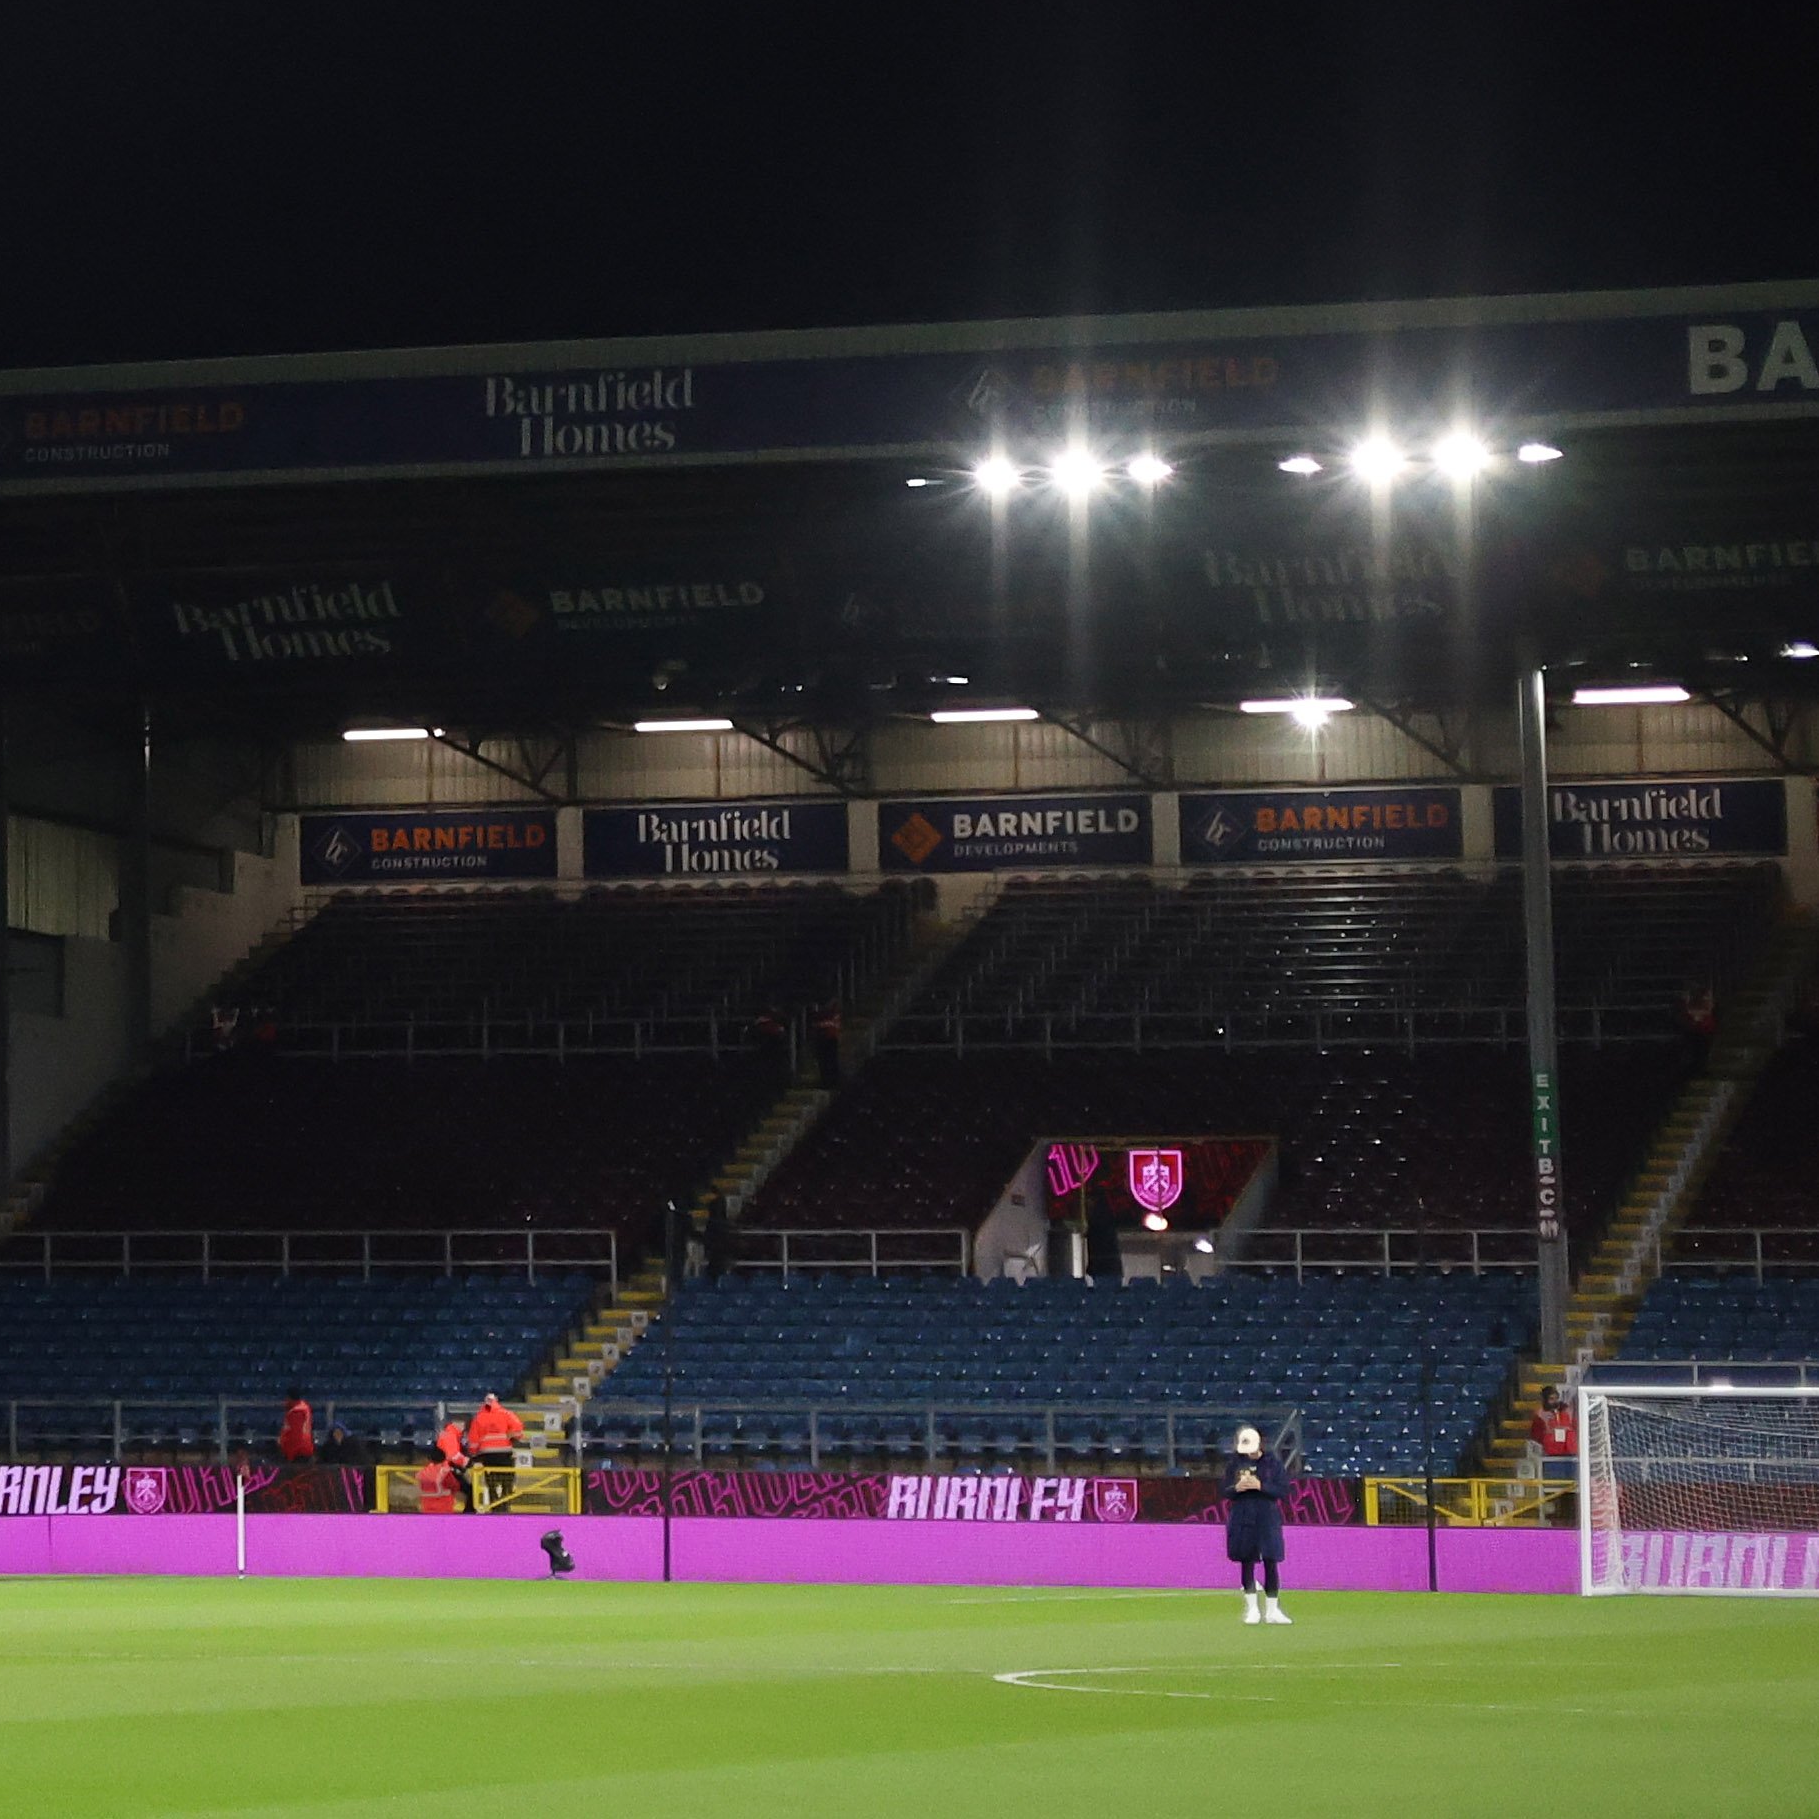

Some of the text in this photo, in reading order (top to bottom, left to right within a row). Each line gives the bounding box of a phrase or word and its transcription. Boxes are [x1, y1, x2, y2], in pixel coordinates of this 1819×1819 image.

[486, 369, 694, 419] Barnfield
[24, 401, 245, 439] BARNFIELD
[24, 442, 170, 463] CONSTRUCTION
[520, 416, 675, 458] Homes
[1626, 541, 1819, 571] BARNFIE
[172, 581, 403, 633] Barnfield
[549, 581, 765, 613] BARNFIELD
[221, 626, 391, 661] Homes
[1255, 804, 1448, 834] BARNFIELD
[1553, 787, 1724, 823] Barnfield
[371, 823, 546, 853] BARNFIELD
[638, 807, 791, 843] Barnfield
[953, 809, 1138, 840] BARNFIELD
[1583, 824, 1710, 855] Homes
[665, 841, 779, 873] Homes
[953, 840, 1078, 857] DEVELOPMENTS
[1257, 834, 1385, 852] CONSTRUCTION
[371, 854, 488, 870] CONSTRUCTION
[1535, 1073, 1551, 1155] EXIT
